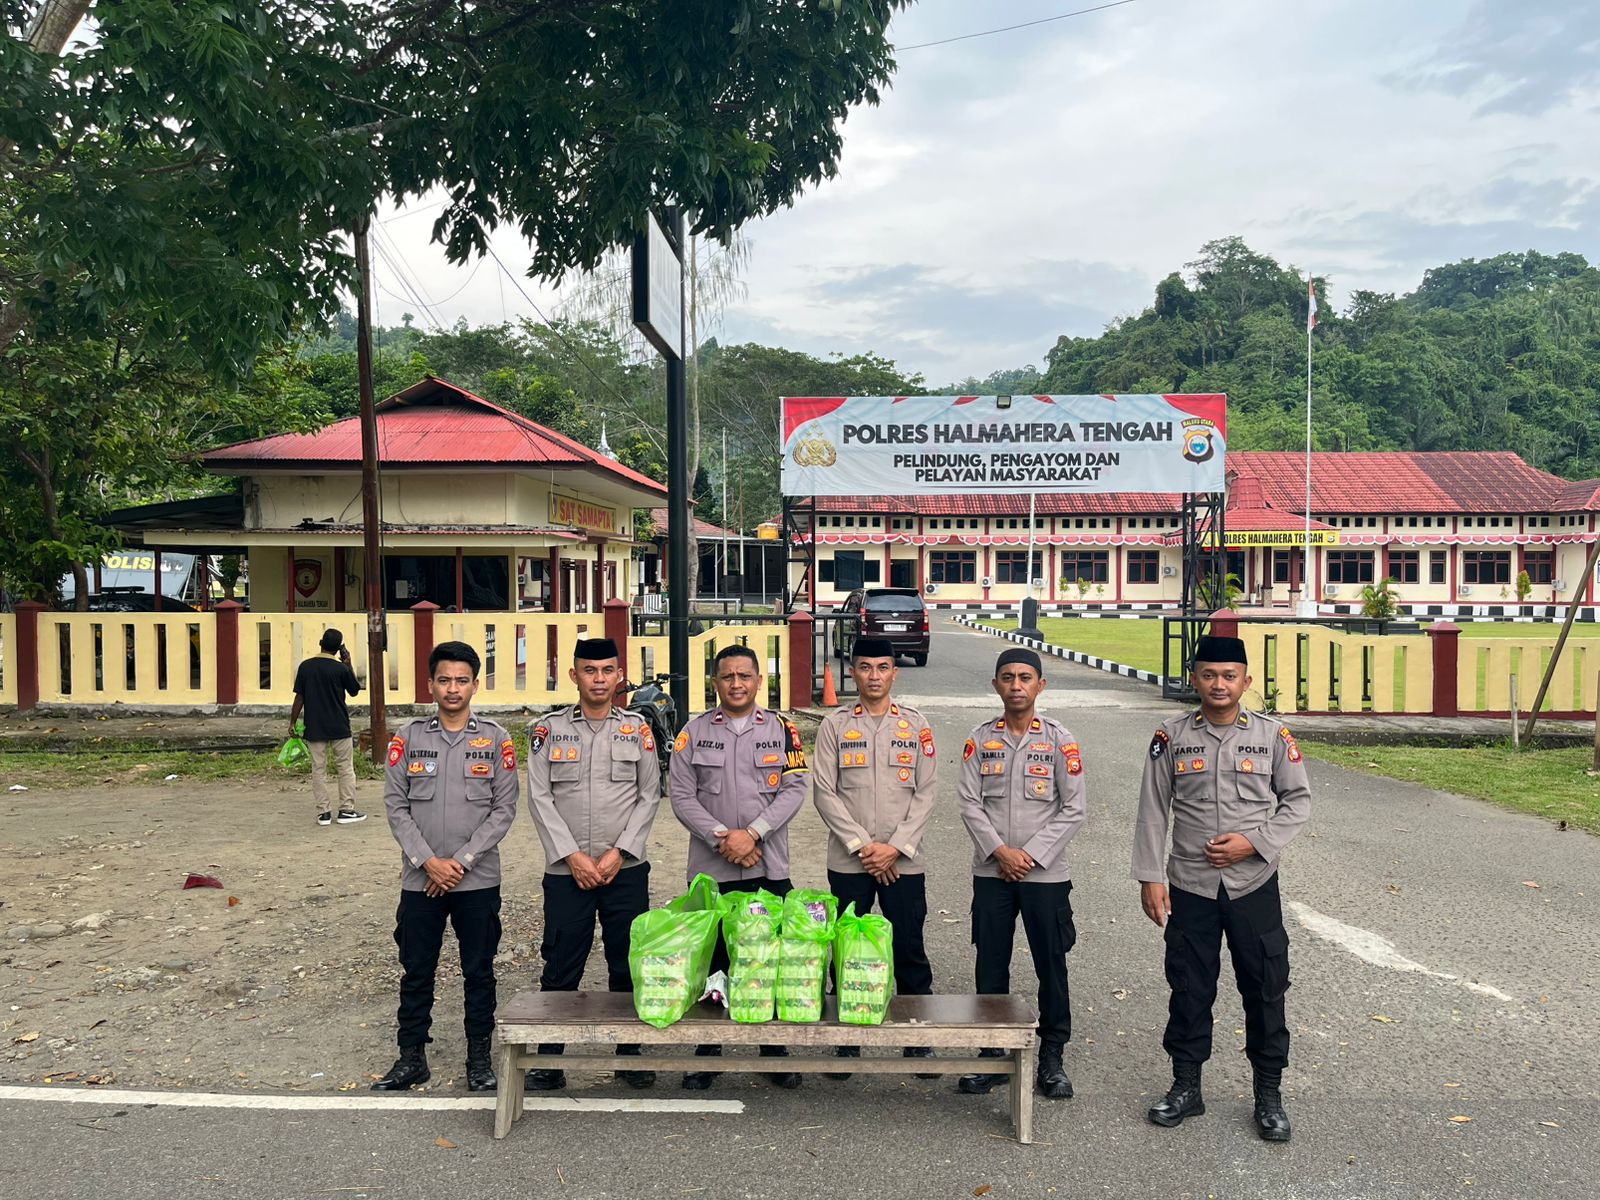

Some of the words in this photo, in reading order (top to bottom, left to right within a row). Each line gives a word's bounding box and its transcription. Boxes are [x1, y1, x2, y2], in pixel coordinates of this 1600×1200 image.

[843, 424, 929, 444] POLRES
[934, 423, 1076, 444] HALMAHERA
[1080, 421, 1173, 442] TENGAH
[893, 454, 987, 470] PELINDUNG,
[990, 452, 1084, 468] PENGAYOM
[1085, 452, 1120, 467] DAN
[915, 468, 987, 483] PELAYAN
[989, 466, 1102, 482] MASYARAKAT
[560, 499, 576, 522] SAT
[577, 503, 612, 530] SAMAPTA
[1224, 533, 1247, 544] OLRES
[1247, 533, 1293, 544] HALMAHERA
[551, 734, 581, 743] IDRIS
[613, 734, 640, 744] POLRI
[696, 740, 725, 750] AZIZ.US
[755, 740, 782, 750] POLRI
[891, 739, 918, 750] POLRI
[1237, 744, 1269, 755] POLRI
[464, 751, 495, 760] POLRI
[1174, 745, 1207, 756] JAROT
[1027, 753, 1054, 763] POLRI
